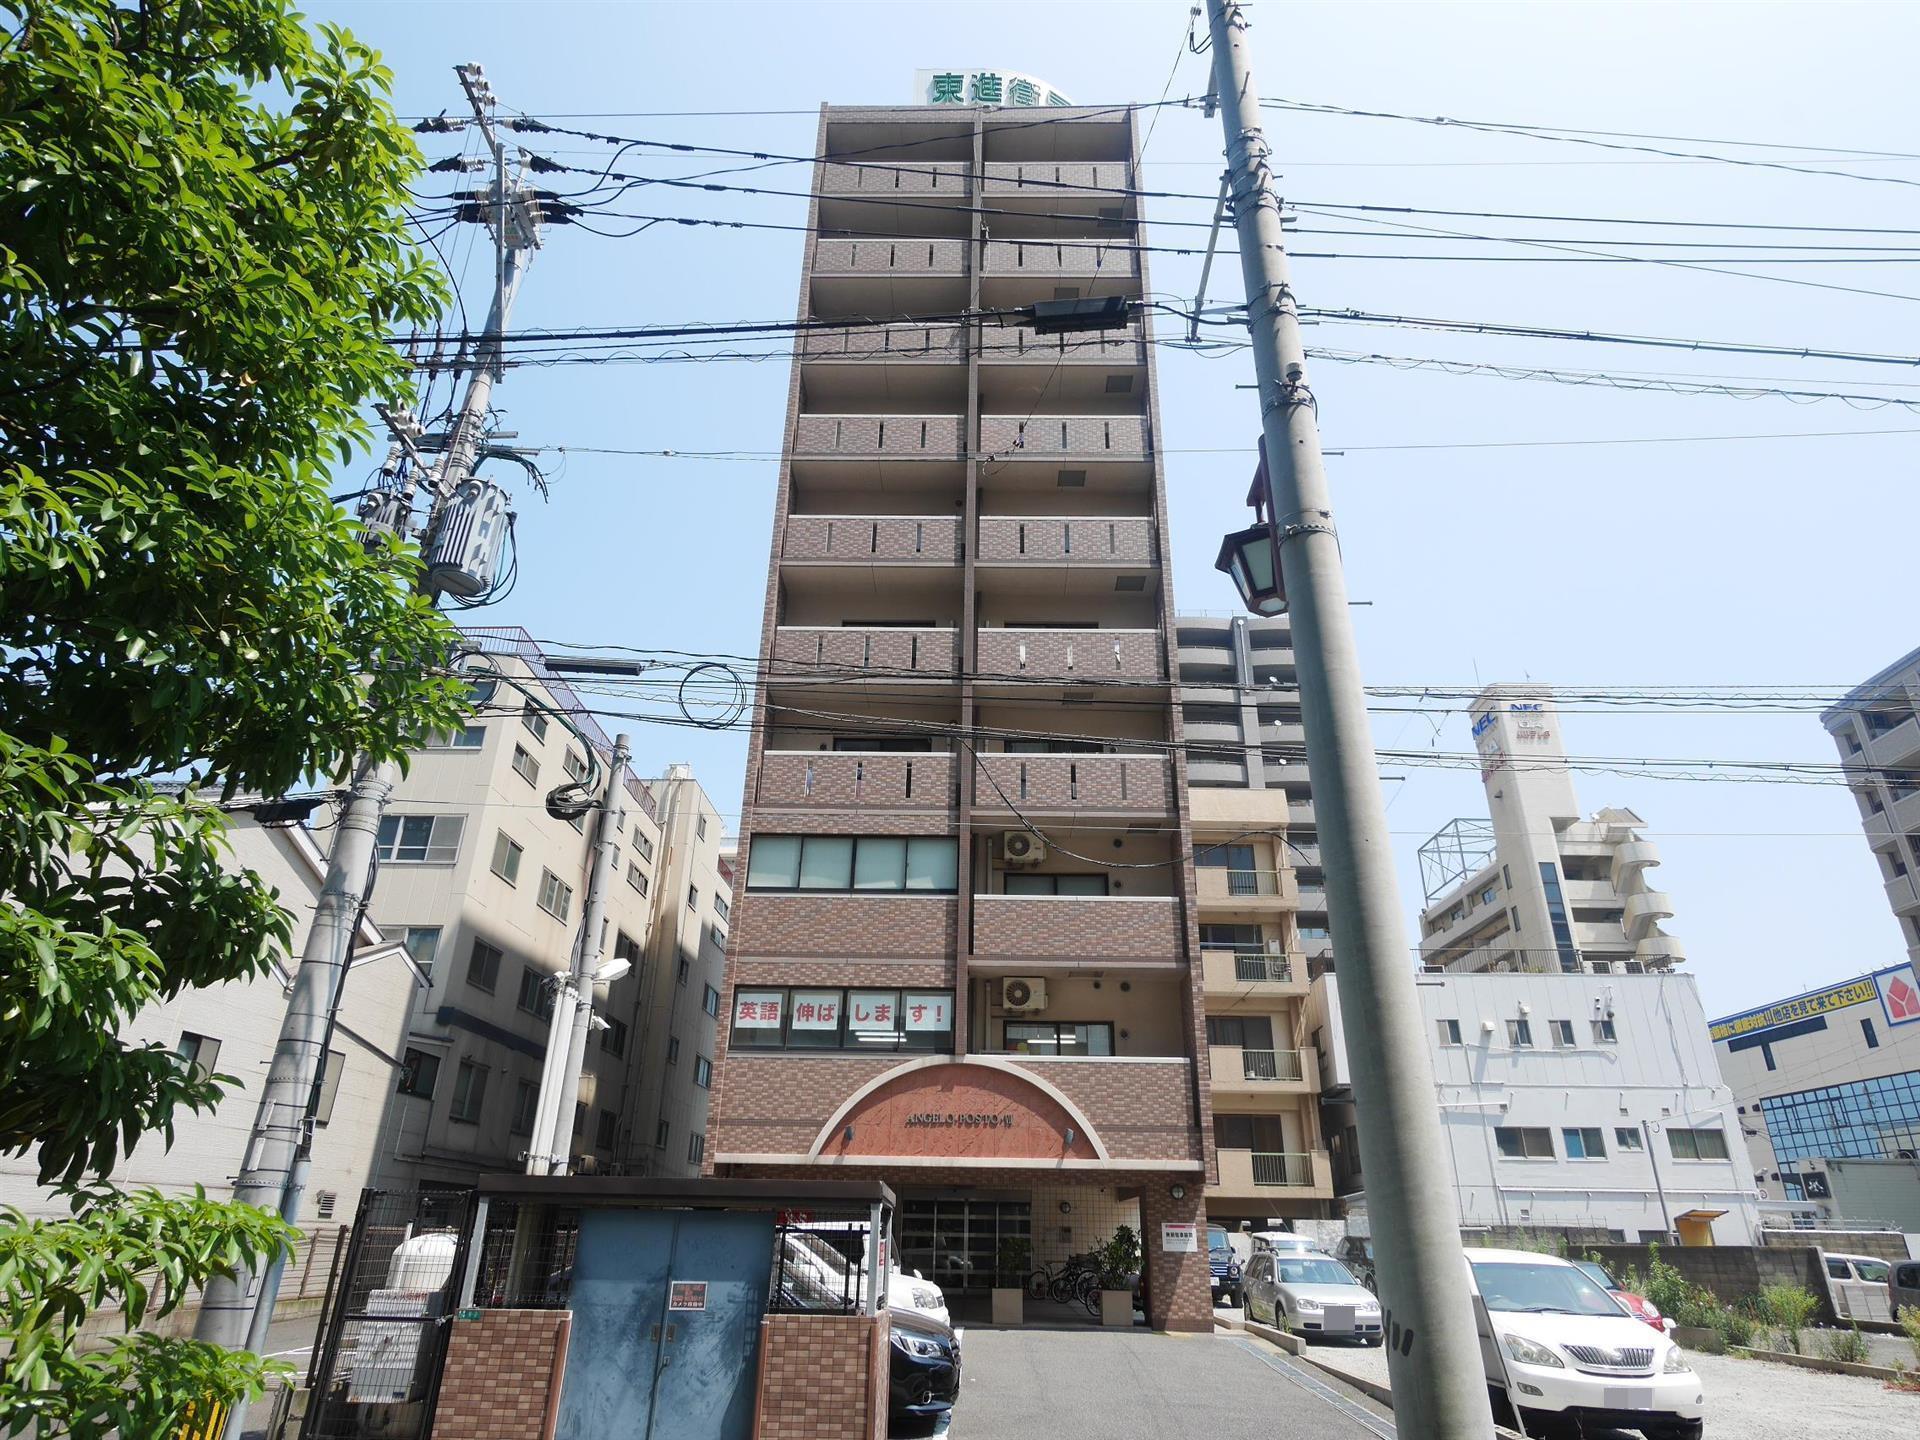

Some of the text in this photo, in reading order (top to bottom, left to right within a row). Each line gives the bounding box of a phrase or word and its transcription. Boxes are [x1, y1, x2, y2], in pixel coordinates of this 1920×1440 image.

[1510, 703, 1543, 711] NEC
[1472, 712, 1495, 735] NEC
[906, 1113, 954, 1125] ANGELO
[958, 1113, 999, 1126] POSTO
